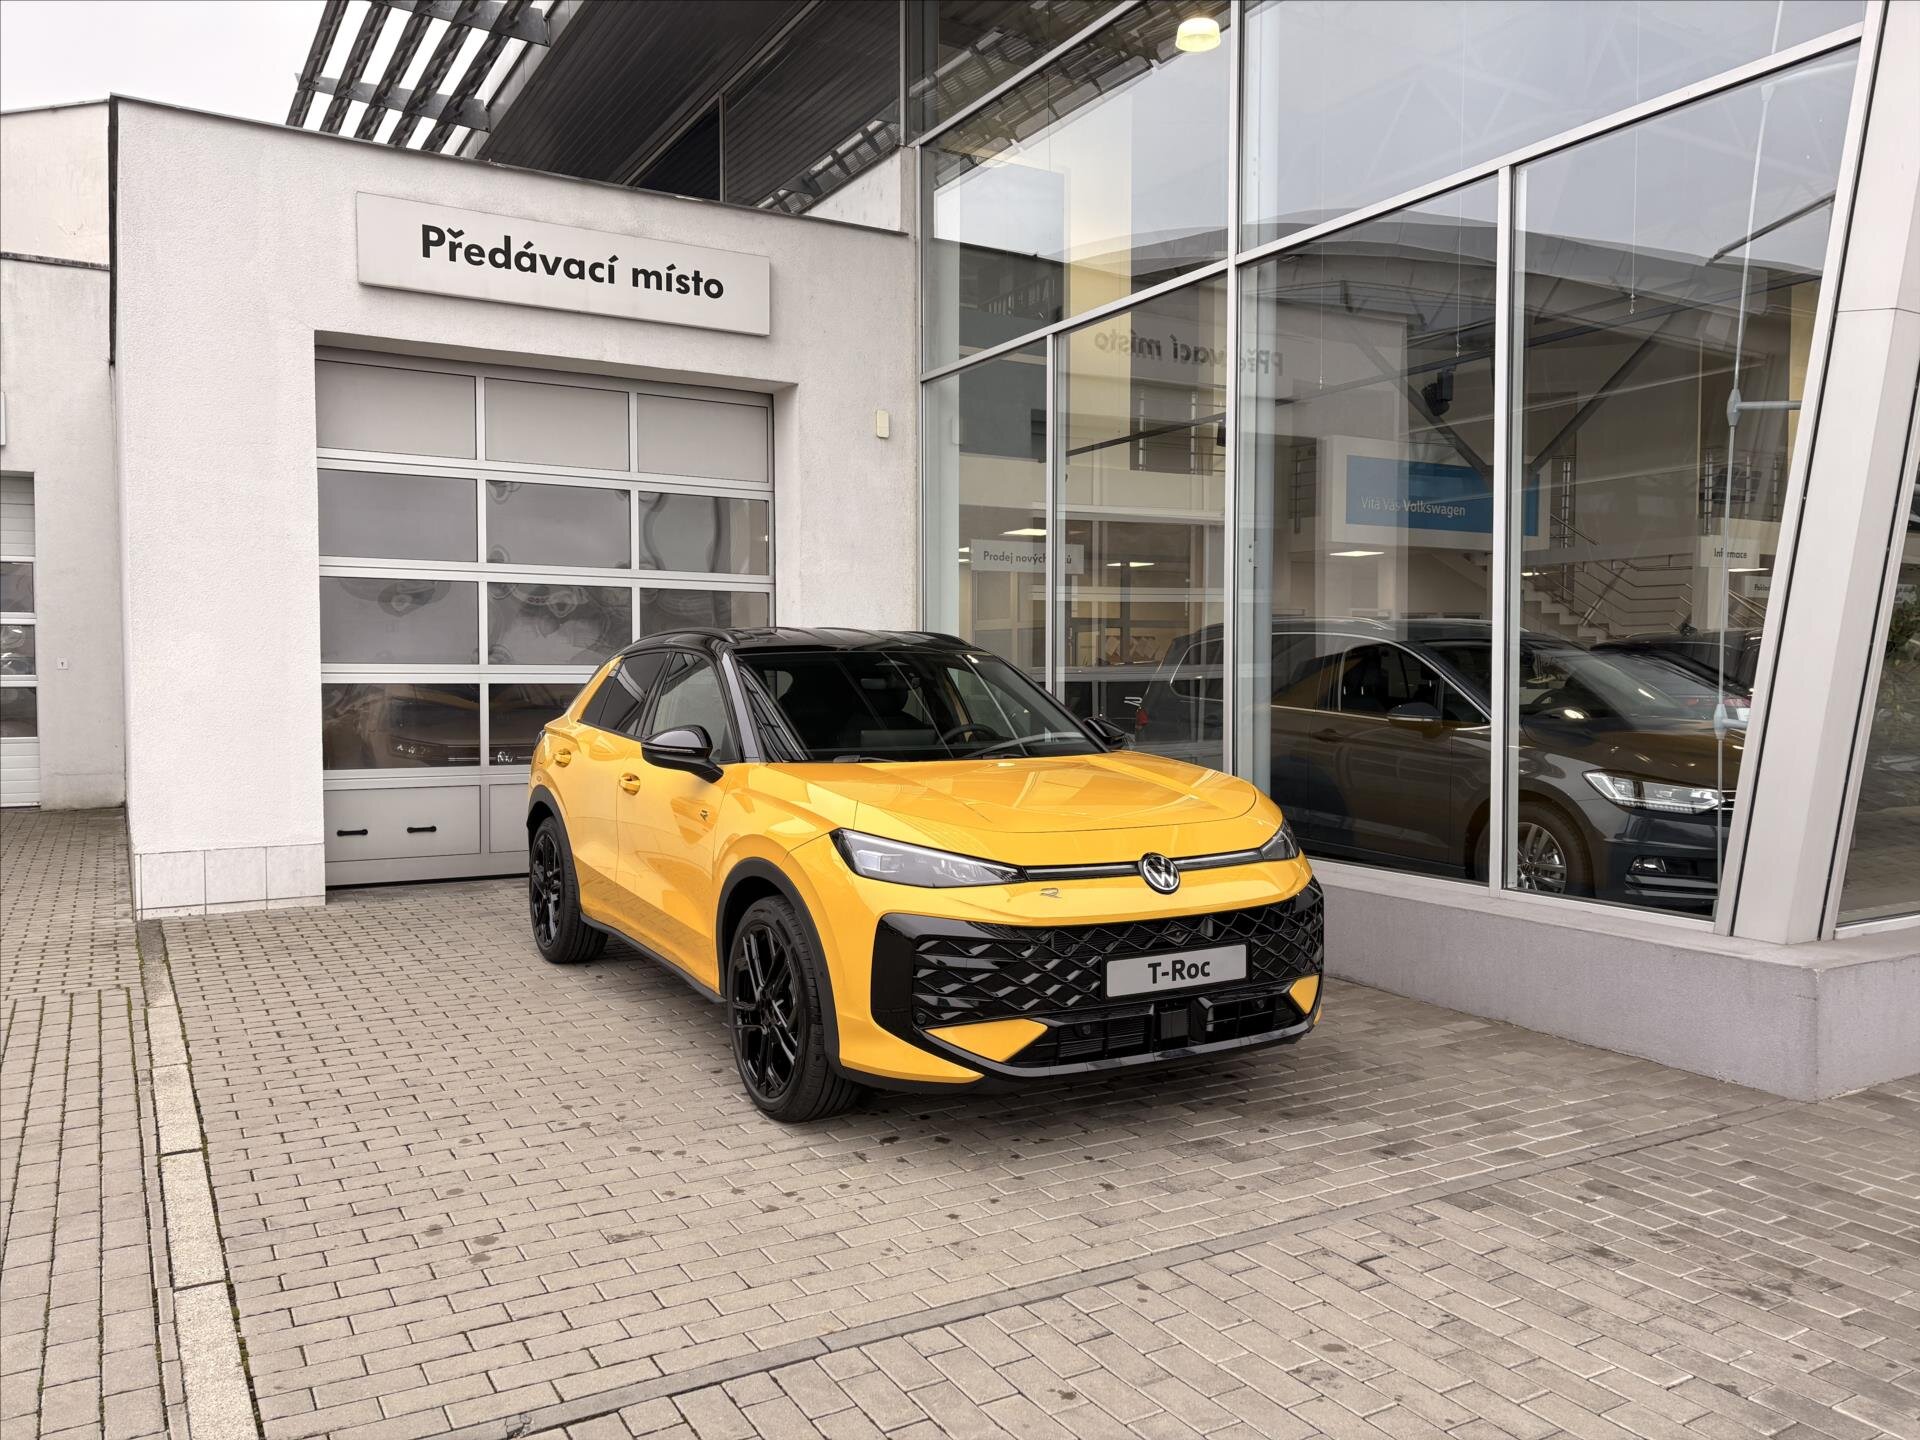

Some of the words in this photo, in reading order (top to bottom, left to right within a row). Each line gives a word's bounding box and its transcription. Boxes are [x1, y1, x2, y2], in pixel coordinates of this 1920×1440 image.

[421, 223, 619, 285] Předávací
[631, 263, 725, 300] místo
[1402, 499, 1466, 518] Volkswagen
[983, 551, 1014, 565] Prodej
[1714, 547, 1748, 559] Infrmace
[1147, 959, 1211, 985] T-Roc
